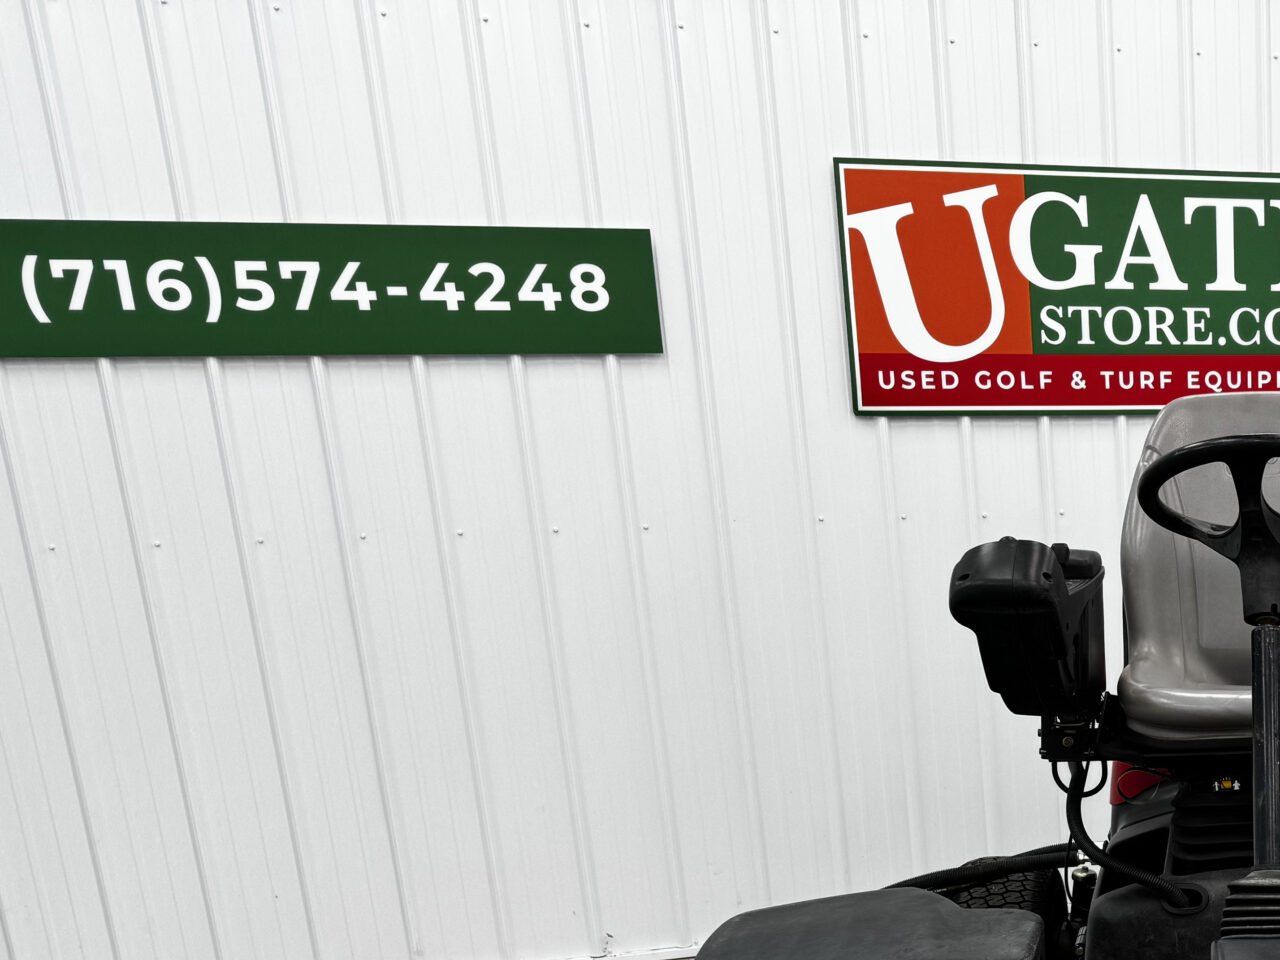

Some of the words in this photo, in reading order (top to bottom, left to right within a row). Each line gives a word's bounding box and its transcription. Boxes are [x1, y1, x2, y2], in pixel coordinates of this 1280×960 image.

[21, 254, 610, 324] (716)574-4248
[878, 370, 959, 390] USED
[975, 370, 1053, 390] GOLF
[1070, 370, 1087, 390] &
[1099, 370, 1173, 390] TURF
